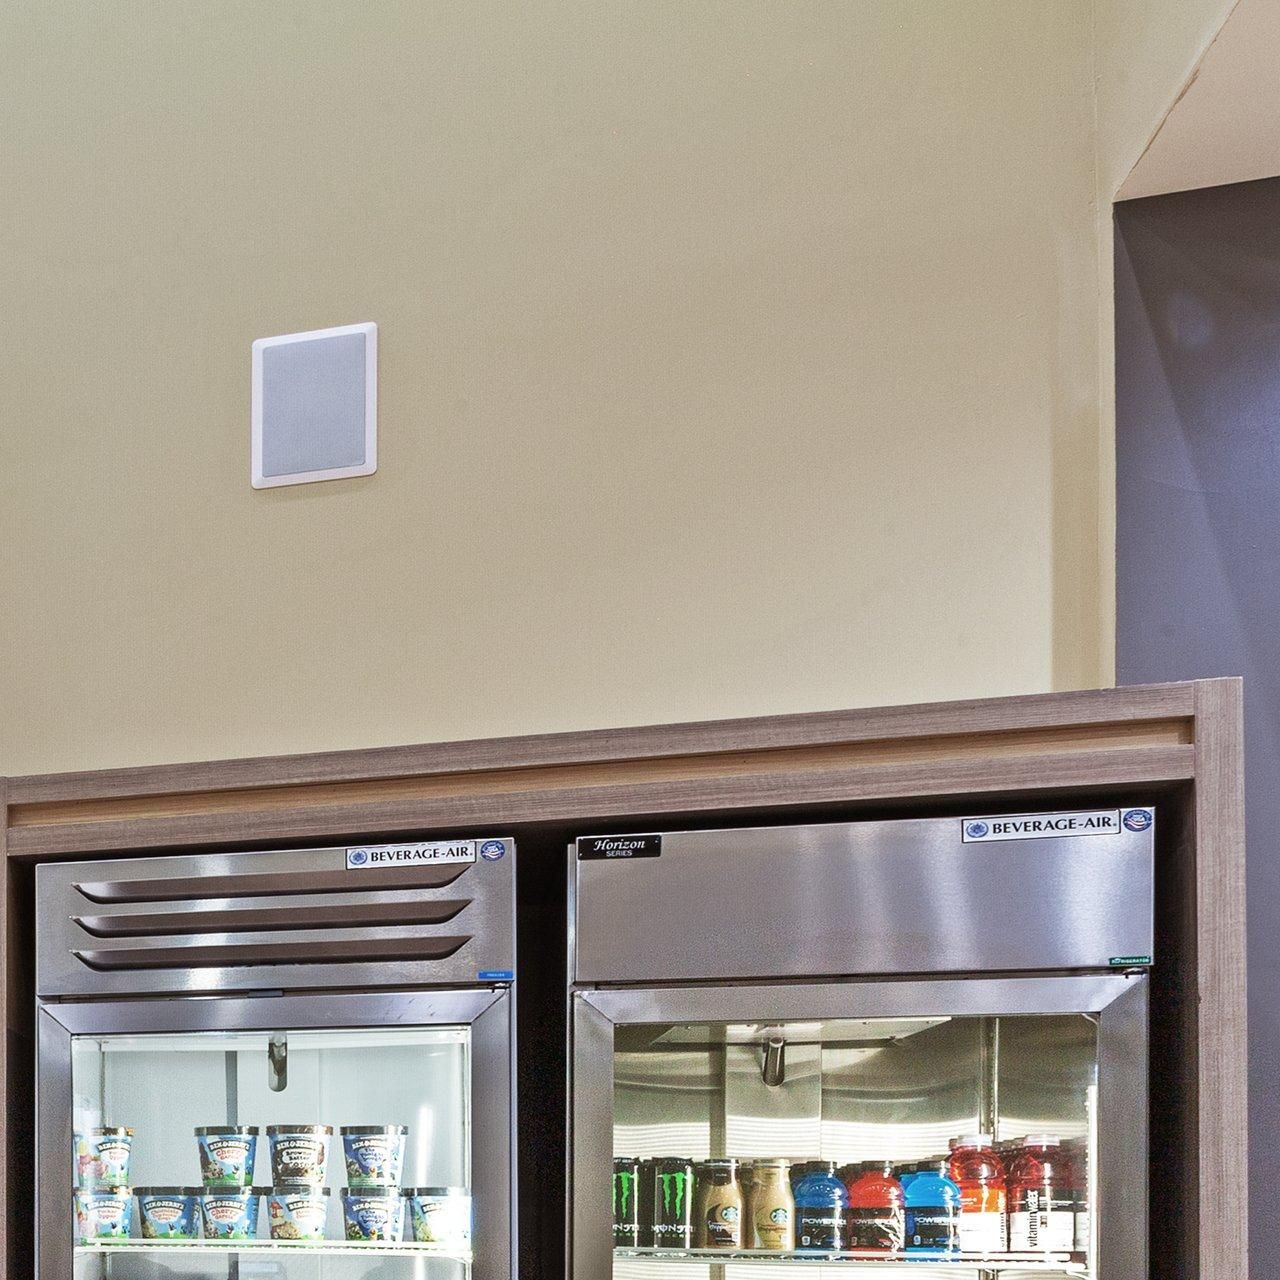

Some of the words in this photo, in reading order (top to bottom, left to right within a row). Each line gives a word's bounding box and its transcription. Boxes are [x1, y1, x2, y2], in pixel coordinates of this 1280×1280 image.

[992, 817, 1112, 834] BEVERAGE-AIR
[592, 838, 646, 851] Horizon
[370, 846, 469, 862] BEVERAGE-AIR
